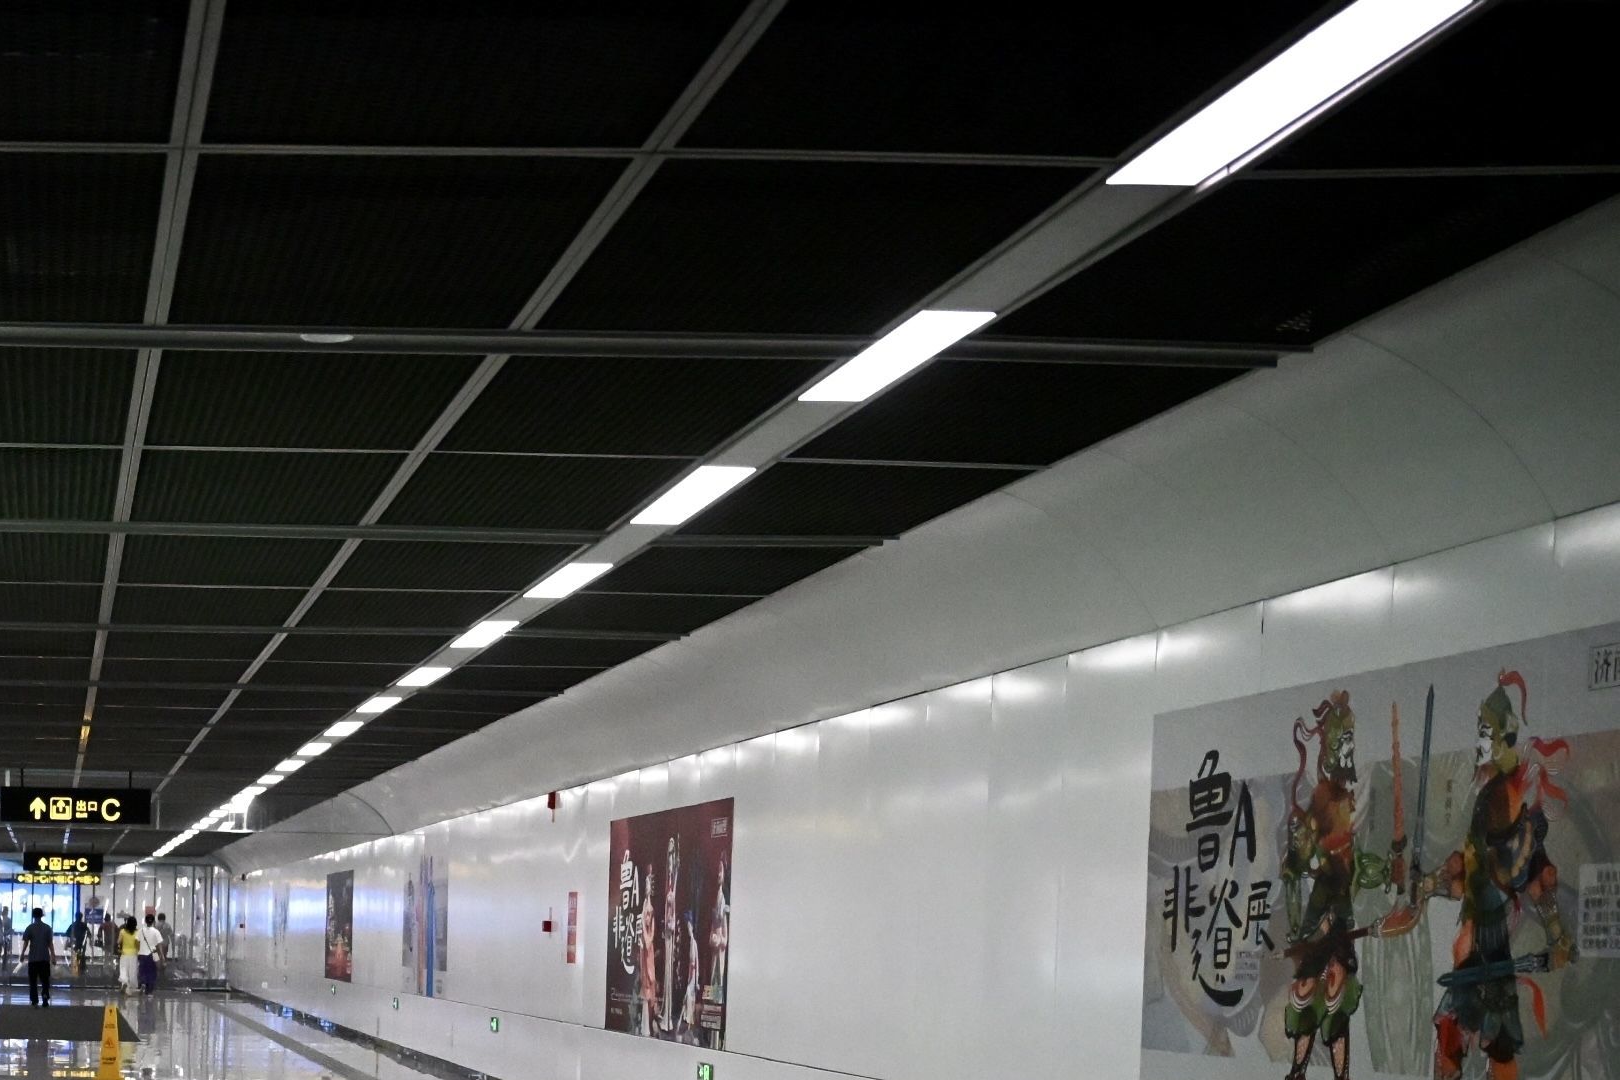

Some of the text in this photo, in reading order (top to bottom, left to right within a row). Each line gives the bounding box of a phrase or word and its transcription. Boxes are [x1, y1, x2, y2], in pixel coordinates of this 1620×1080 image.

[101, 798, 121, 822] C
[1186, 750, 1256, 872] 鲁A
[77, 858, 88, 872] C
